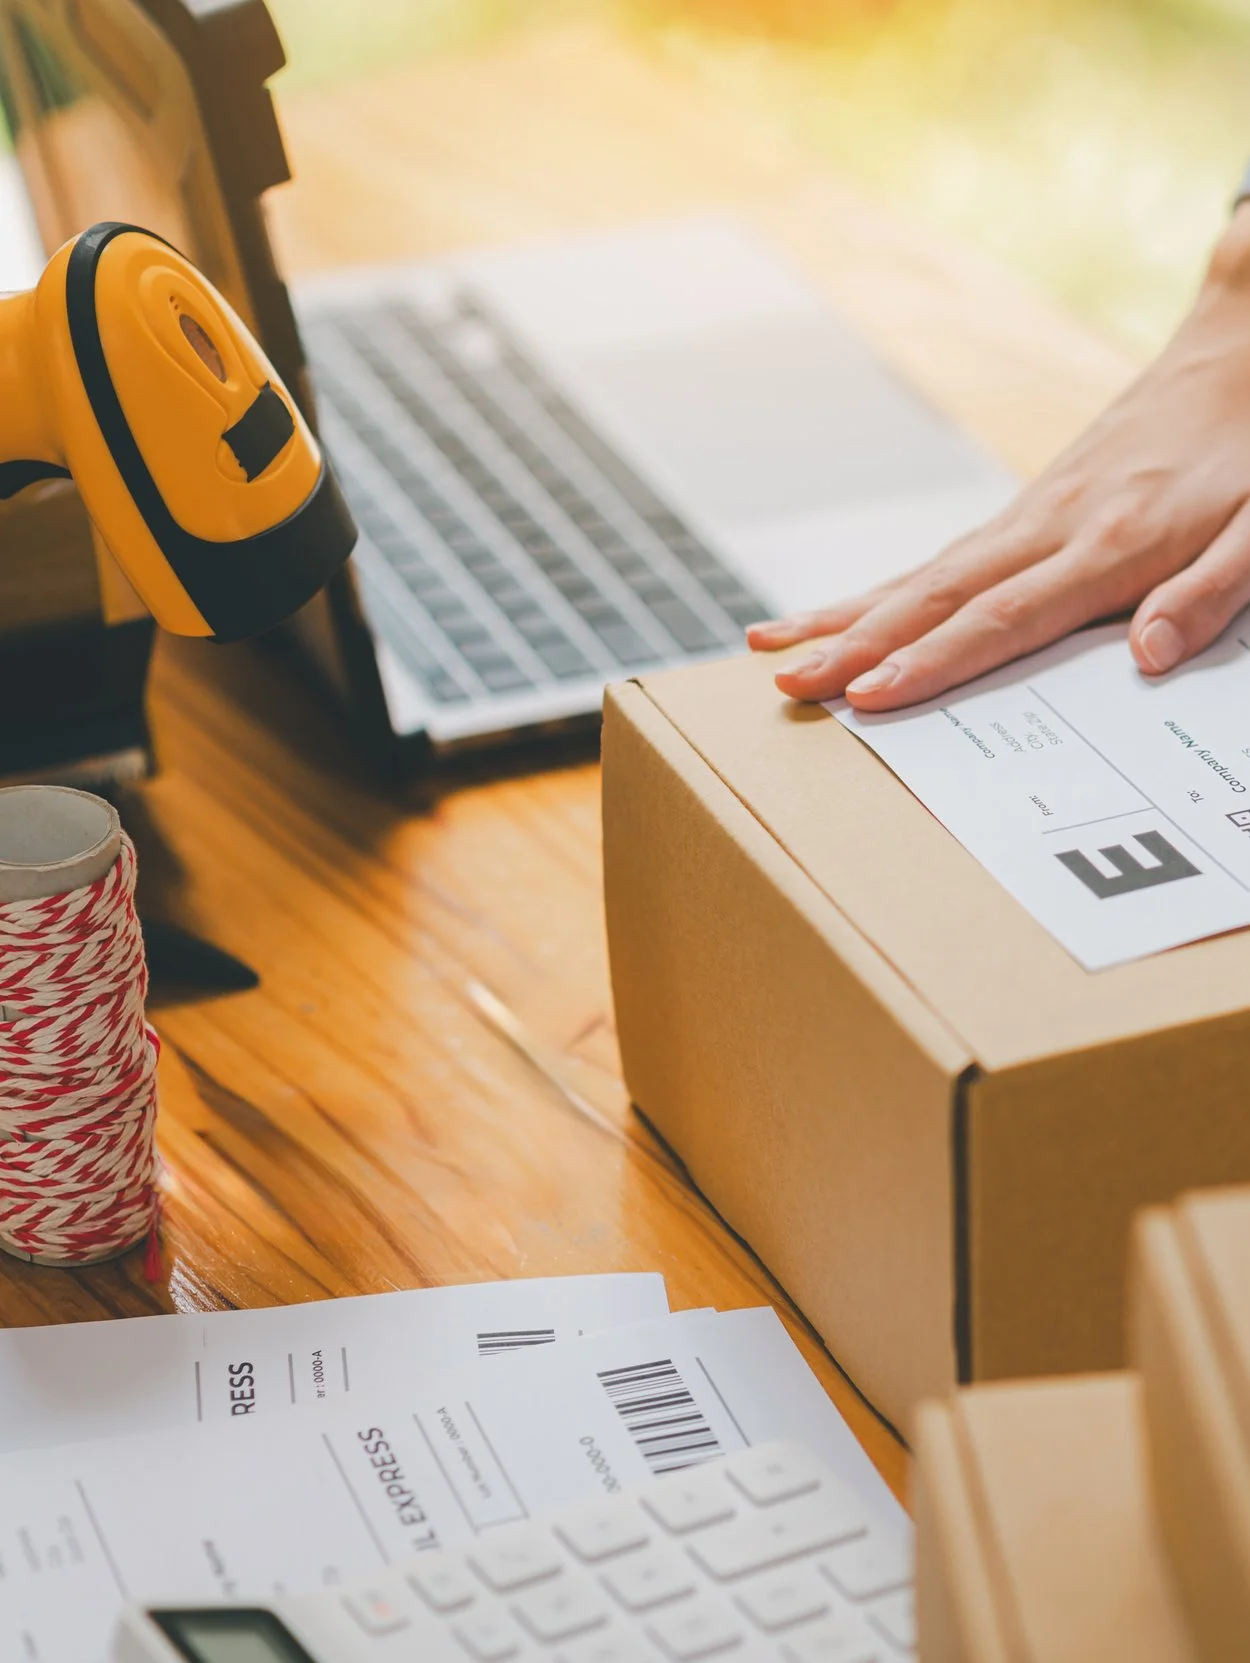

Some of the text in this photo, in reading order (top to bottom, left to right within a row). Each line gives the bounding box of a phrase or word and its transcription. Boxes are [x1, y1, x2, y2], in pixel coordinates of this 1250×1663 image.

[939, 707, 996, 759] Company Name
[990, 722, 1026, 753] Address
[1023, 711, 1063, 746] State Zip
[1164, 720, 1246, 793] Company Name
[1029, 795, 1054, 816] From:
[1187, 789, 1205, 804] To:
[1054, 830, 1203, 900] E
[312, 1350, 324, 1383] 0000-A
[228, 1361, 255, 1416] RESS
[357, 1427, 426, 1526] EXPRESS
